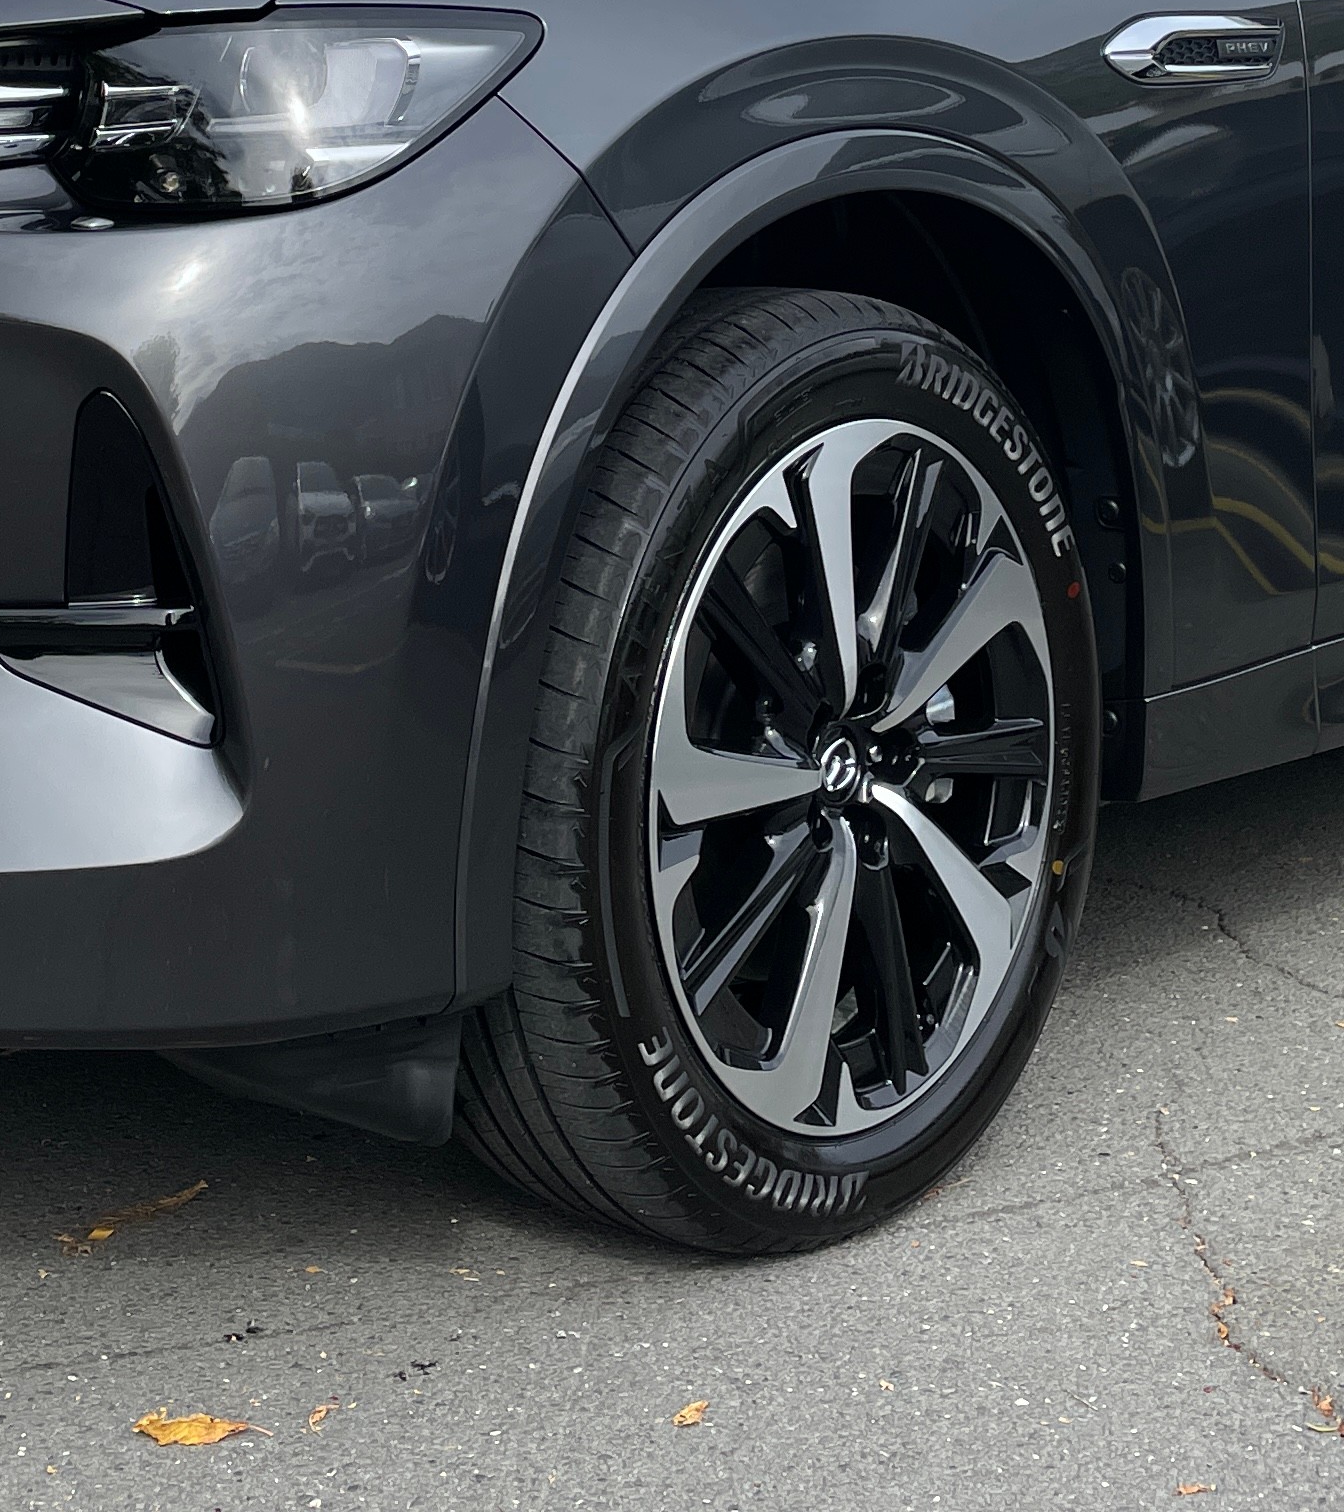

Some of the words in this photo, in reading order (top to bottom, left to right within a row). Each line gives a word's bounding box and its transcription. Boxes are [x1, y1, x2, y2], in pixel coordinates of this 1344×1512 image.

[1225, 41, 1270, 55] PHEV
[896, 342, 1077, 558] BRIDGESTONE
[636, 1025, 871, 1218] BRIDGESTONE
